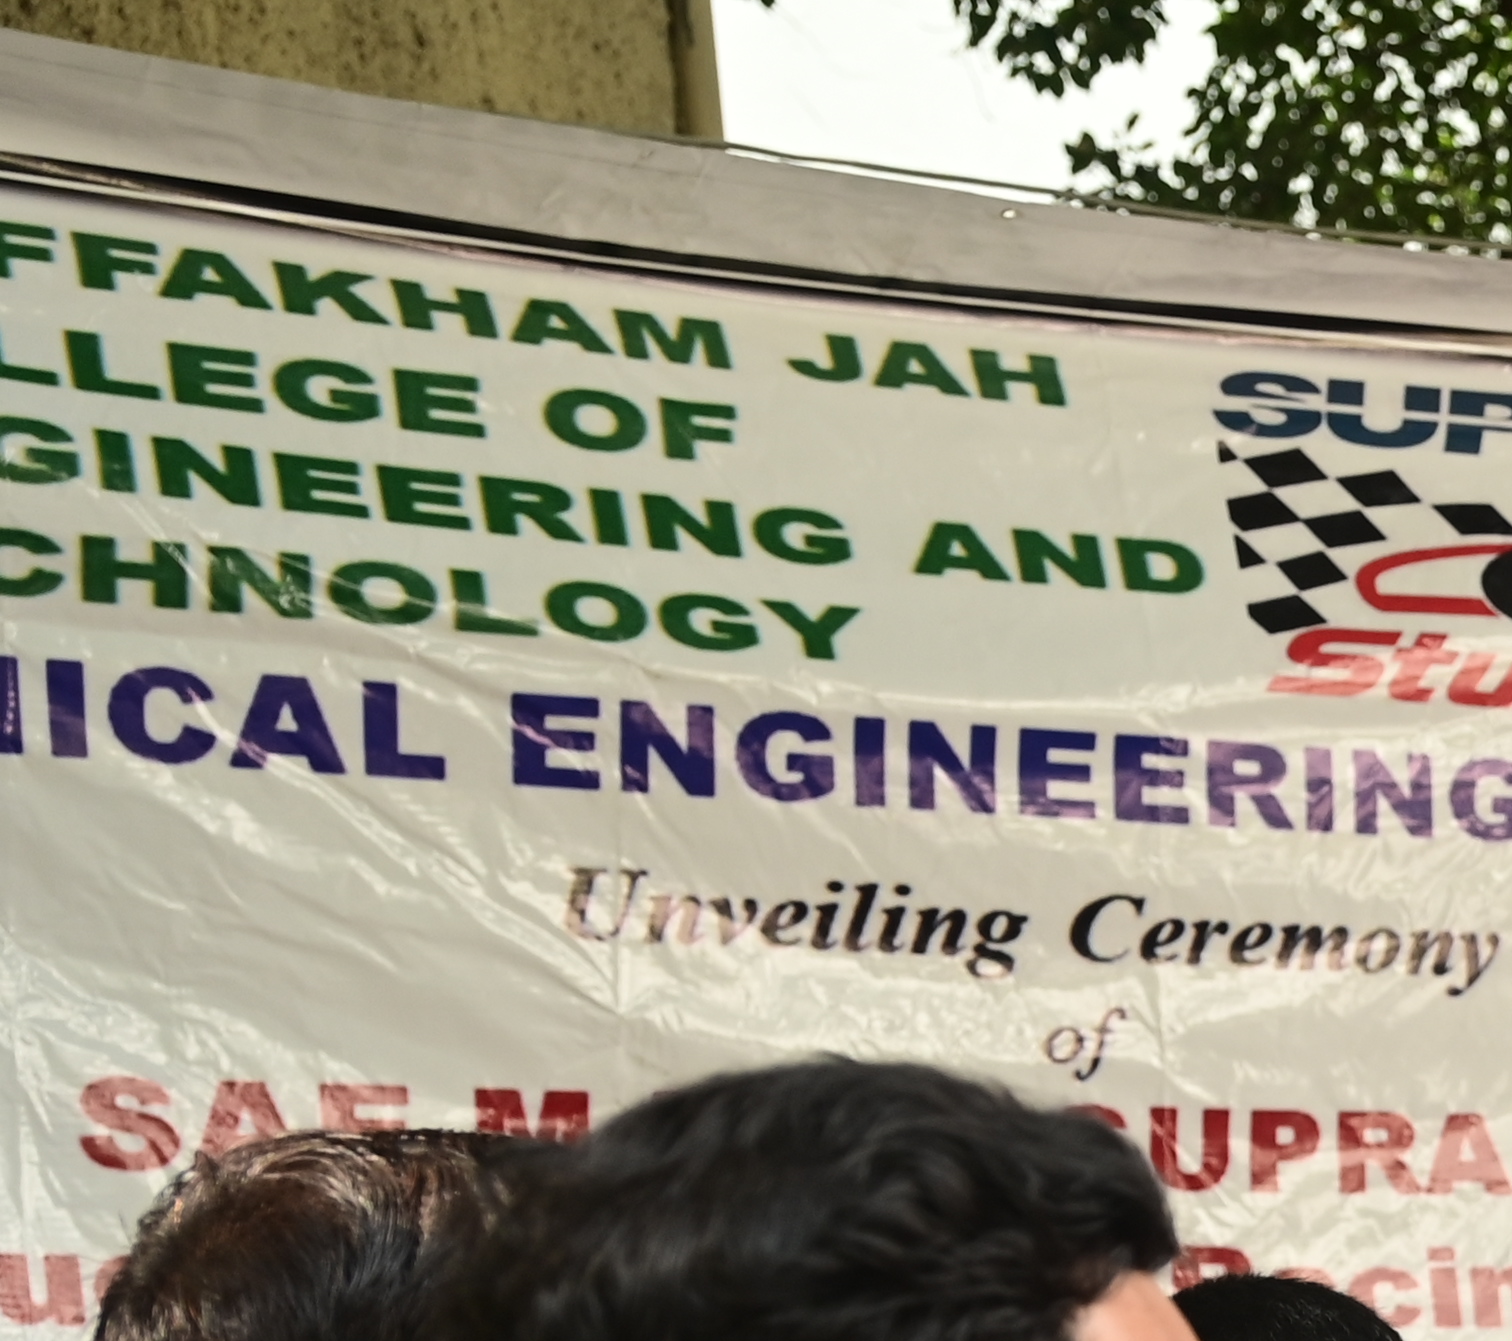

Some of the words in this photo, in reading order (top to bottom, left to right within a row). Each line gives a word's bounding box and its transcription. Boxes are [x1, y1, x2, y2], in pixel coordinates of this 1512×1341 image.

[790, 331, 1067, 406] JAH
[544, 387, 738, 461] OF
[0, 415, 854, 566] GINEERING
[915, 521, 1207, 595] AND
[0, 655, 449, 781] ICAL
[564, 866, 1029, 978] Unveiling
[1069, 893, 1500, 996] Ceremony
[1046, 1007, 1127, 1081] of
